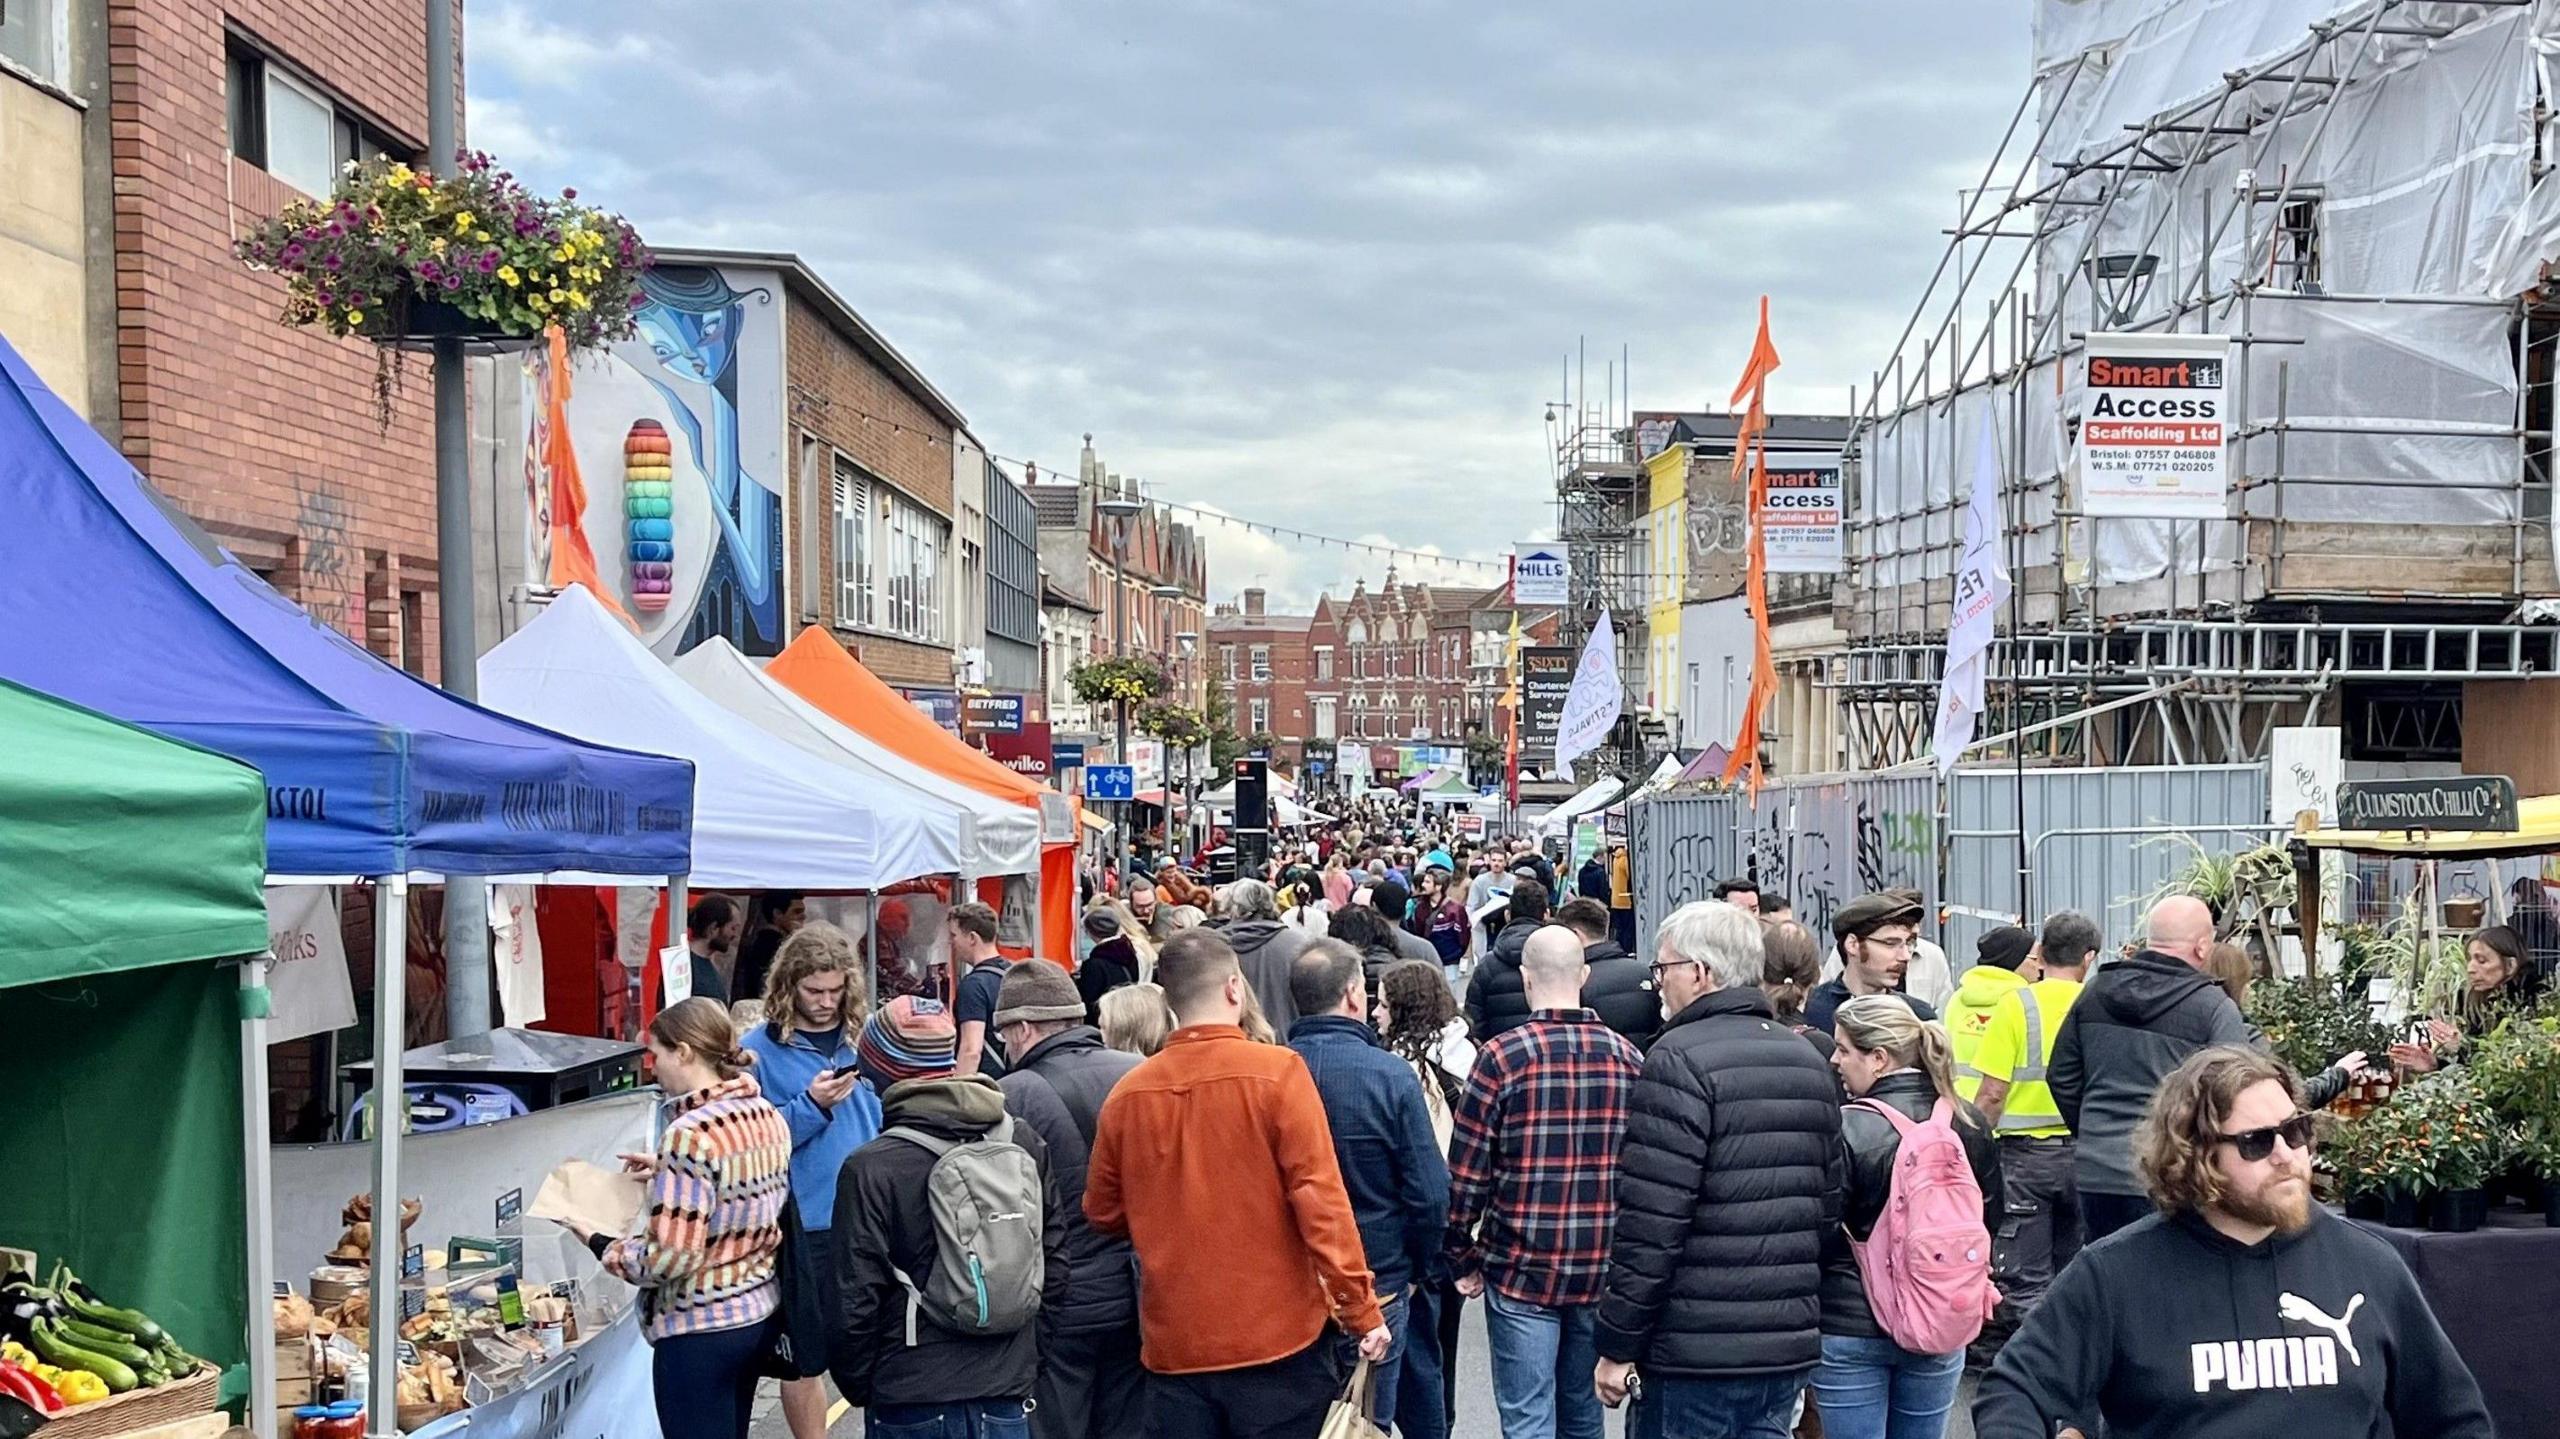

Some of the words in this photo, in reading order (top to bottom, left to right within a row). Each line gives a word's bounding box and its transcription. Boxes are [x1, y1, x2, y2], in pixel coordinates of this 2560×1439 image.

[2090, 358, 2189, 387] Smart
[2092, 393, 2216, 418] Access
[2089, 426, 2185, 443] Scaffolding
[2191, 427, 2218, 441] Ltd
[2090, 449, 2131, 459] Bristol:
[2135, 450, 2170, 459] 07557
[2174, 451, 2216, 460] 046808
[2133, 462, 2167, 471] 07721
[1766, 470, 1817, 486] mart
[1764, 494, 1835, 507] ccess
[1818, 513, 1837, 522] Ltd
[1518, 563, 1563, 576] HILLS
[1528, 681, 1571, 690] Chartered
[1528, 690, 1568, 700] Surveyor
[968, 699, 1018, 709] BETFRED
[1002, 755, 1046, 771] wilko
[267, 787, 326, 820] ISTOL
[2191, 1336, 2338, 1392] PUMA
